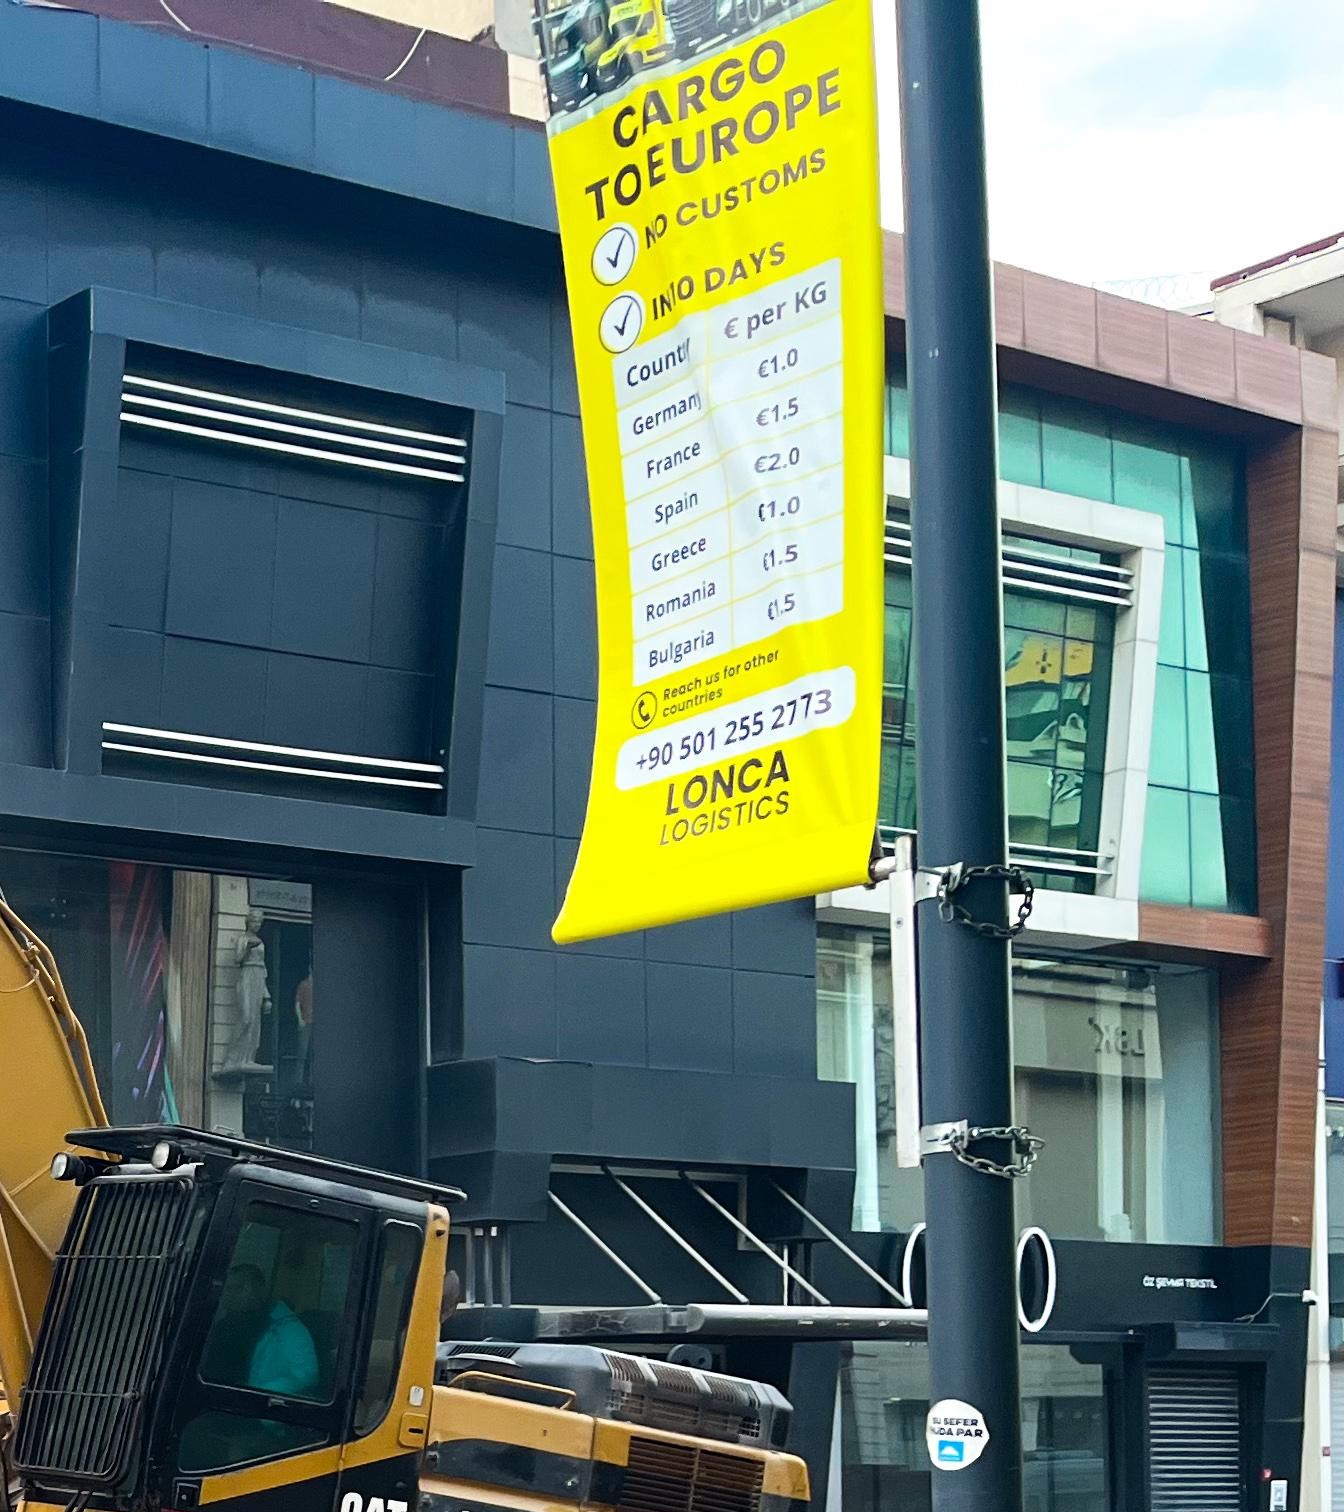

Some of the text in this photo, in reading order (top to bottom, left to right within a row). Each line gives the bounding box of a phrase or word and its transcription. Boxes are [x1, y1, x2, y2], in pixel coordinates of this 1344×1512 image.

[613, 40, 785, 147] CARGO
[645, 148, 826, 248] NO CUSTOMS
[705, 242, 786, 292] DAYS
[747, 301, 786, 339] per
[795, 281, 827, 313] KG
[759, 348, 798, 378] €1.0
[756, 398, 798, 426] €1.5
[646, 441, 701, 478] France
[754, 447, 799, 473] €2.0
[655, 492, 698, 524] Spain
[651, 537, 706, 571] Greece
[646, 580, 716, 621] Romania
[649, 630, 714, 667] Bulgaria
[664, 650, 779, 700] Reach us for other
[663, 687, 723, 717] countries
[636, 689, 832, 770] +90 501 255 2773
[665, 750, 790, 816] LONCA
[659, 791, 789, 845] LOGISTICS
